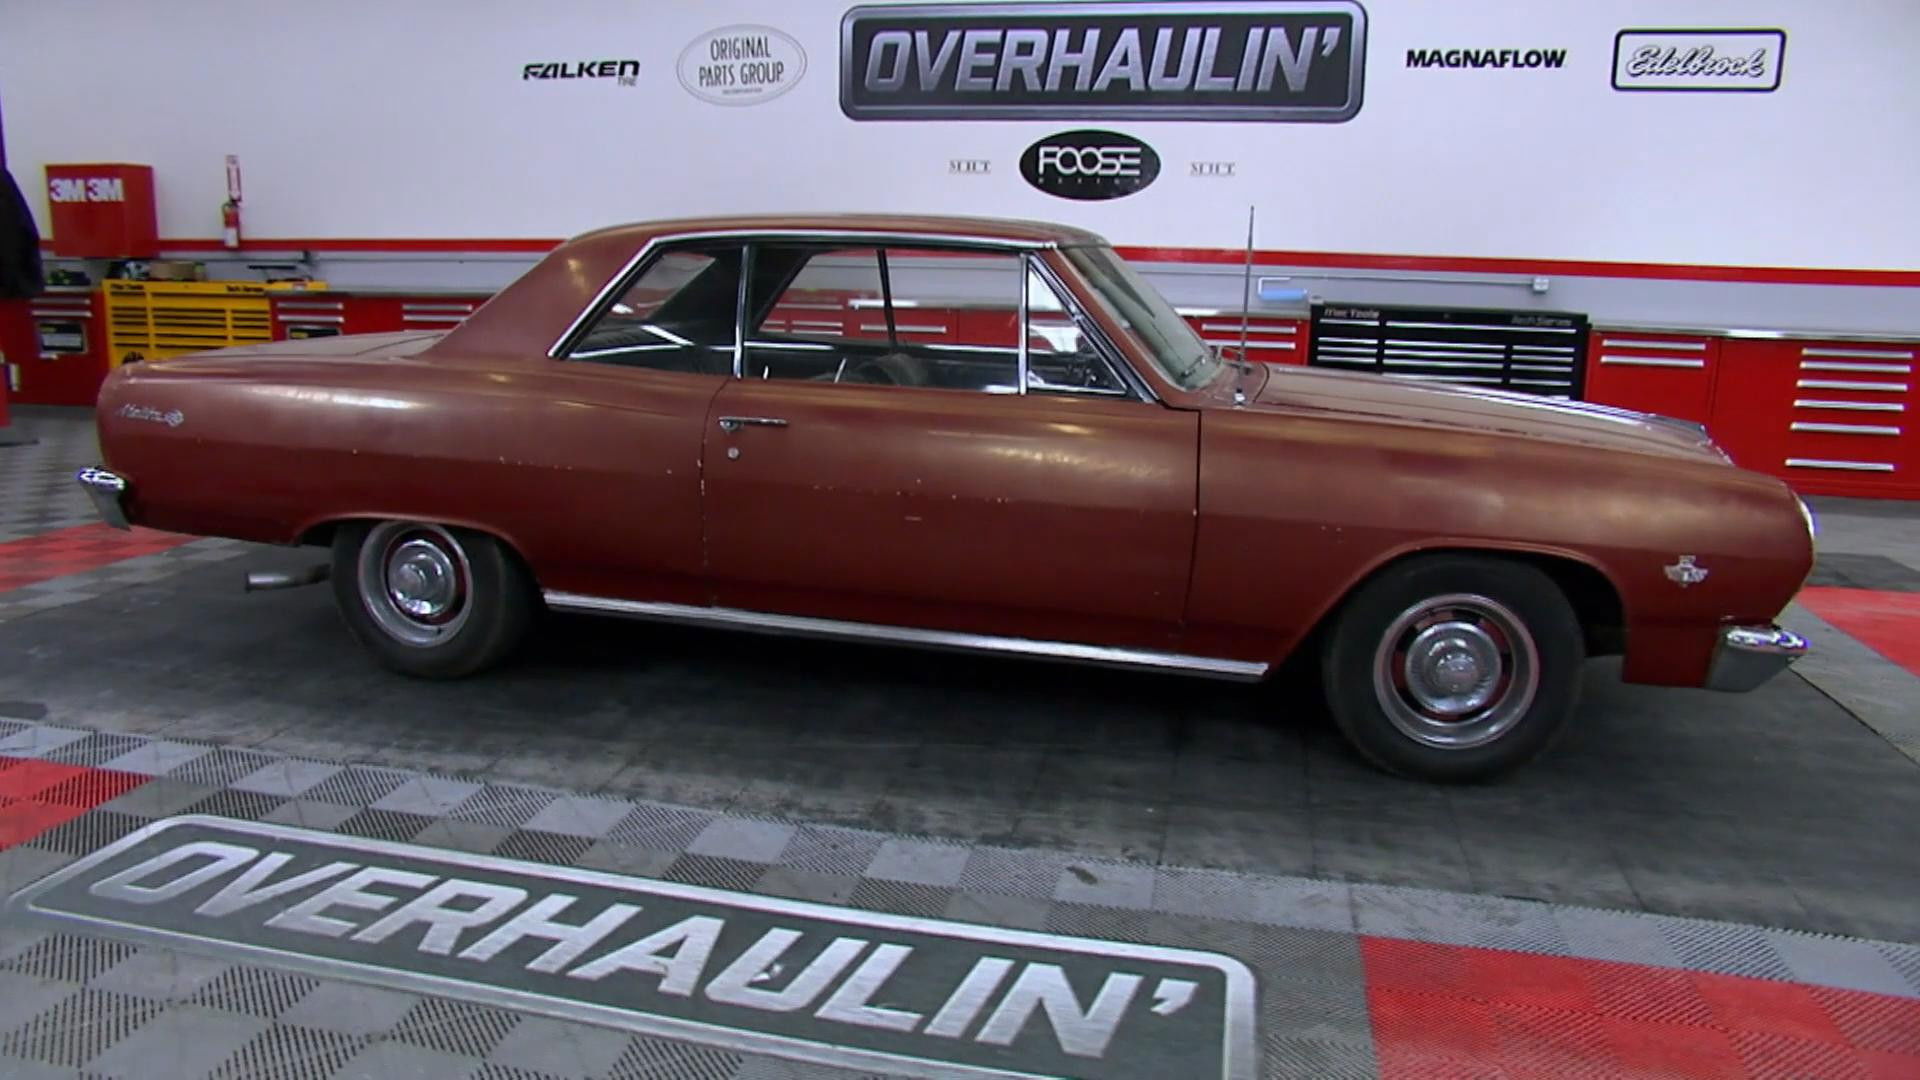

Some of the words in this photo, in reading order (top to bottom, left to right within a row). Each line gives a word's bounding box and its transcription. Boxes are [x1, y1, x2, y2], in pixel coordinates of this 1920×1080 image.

[710, 36, 772, 61] ORIGINAL
[864, 26, 1341, 92] OVERHAULIN'
[1406, 49, 1567, 69] MAGNAFLOW
[1626, 44, 1767, 77] Edelbrock
[523, 60, 641, 80] FALKEN
[699, 65, 736, 87] PARTS
[740, 61, 785, 84] GROUP
[1038, 146, 1141, 175] FOOSE
[50, 178, 87, 202] 3M
[87, 178, 125, 202] 3M
[88, 841, 1199, 1059] OVERHAULIN'
